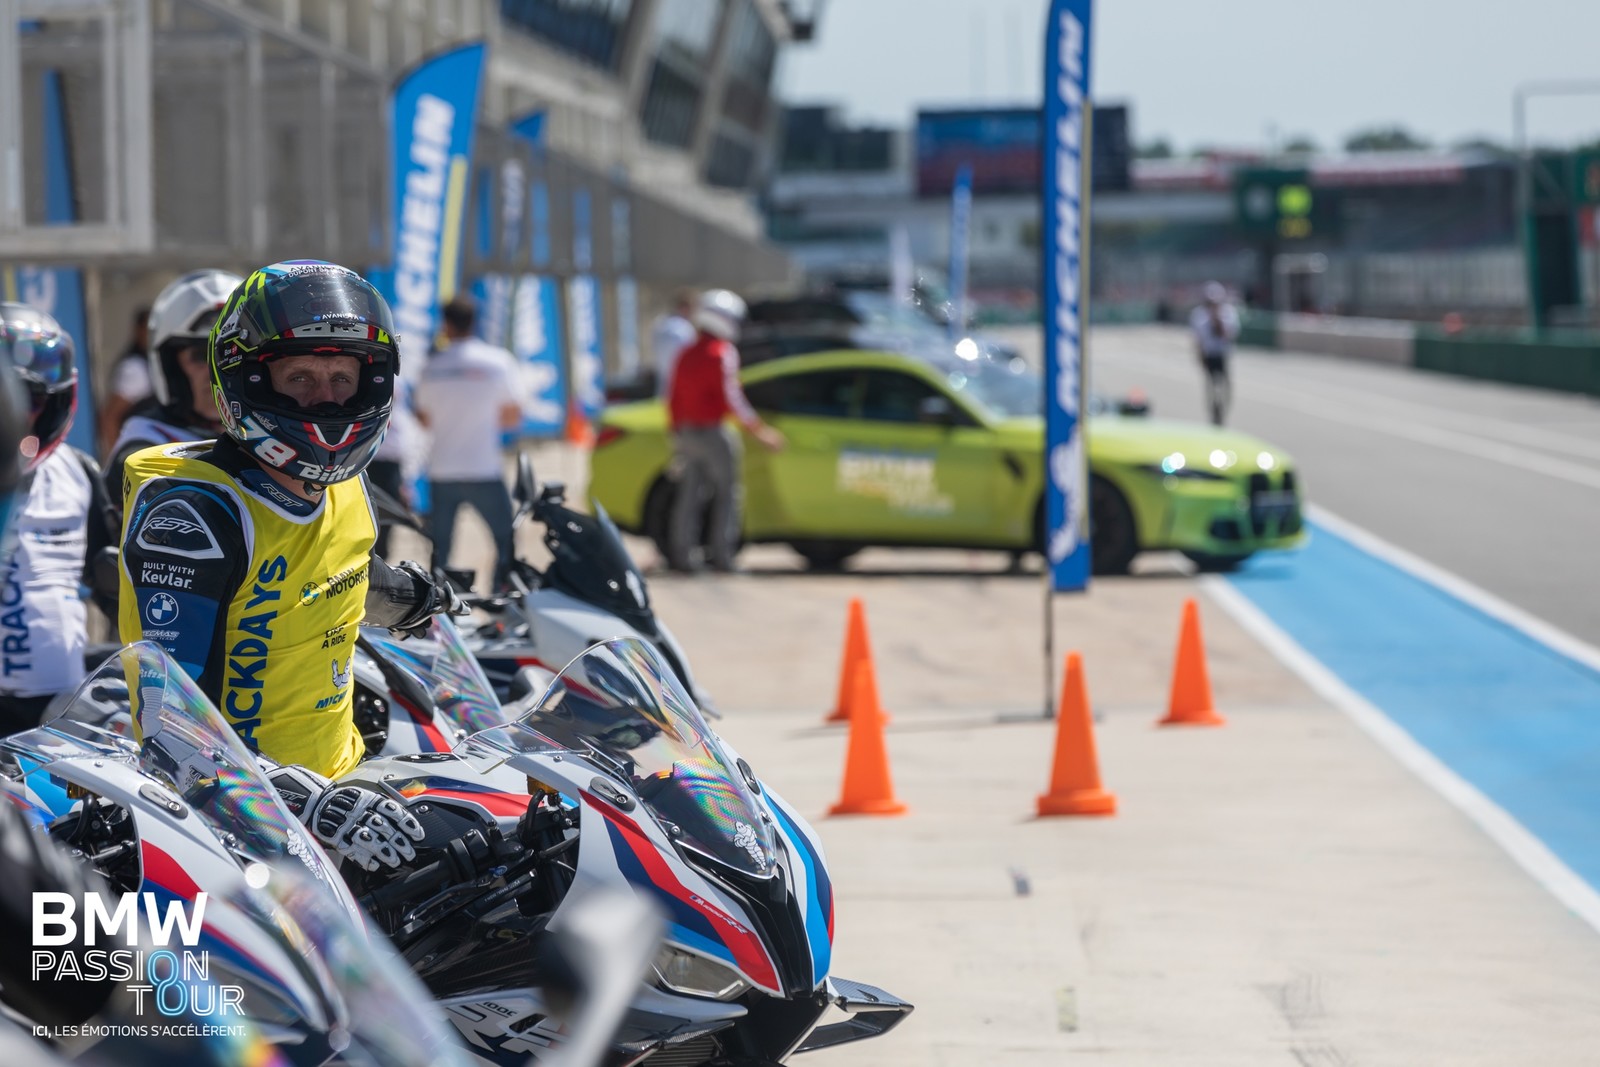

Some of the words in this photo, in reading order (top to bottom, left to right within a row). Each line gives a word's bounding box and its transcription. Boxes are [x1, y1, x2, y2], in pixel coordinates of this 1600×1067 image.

[241, 416, 298, 468] 78
[297, 460, 356, 482] Bihr
[260, 483, 303, 508] RST
[142, 517, 206, 535] RST
[143, 561, 166, 571] BUILT
[168, 564, 196, 576] WITH
[321, 640, 329, 649] A
[331, 634, 347, 647] RIDE
